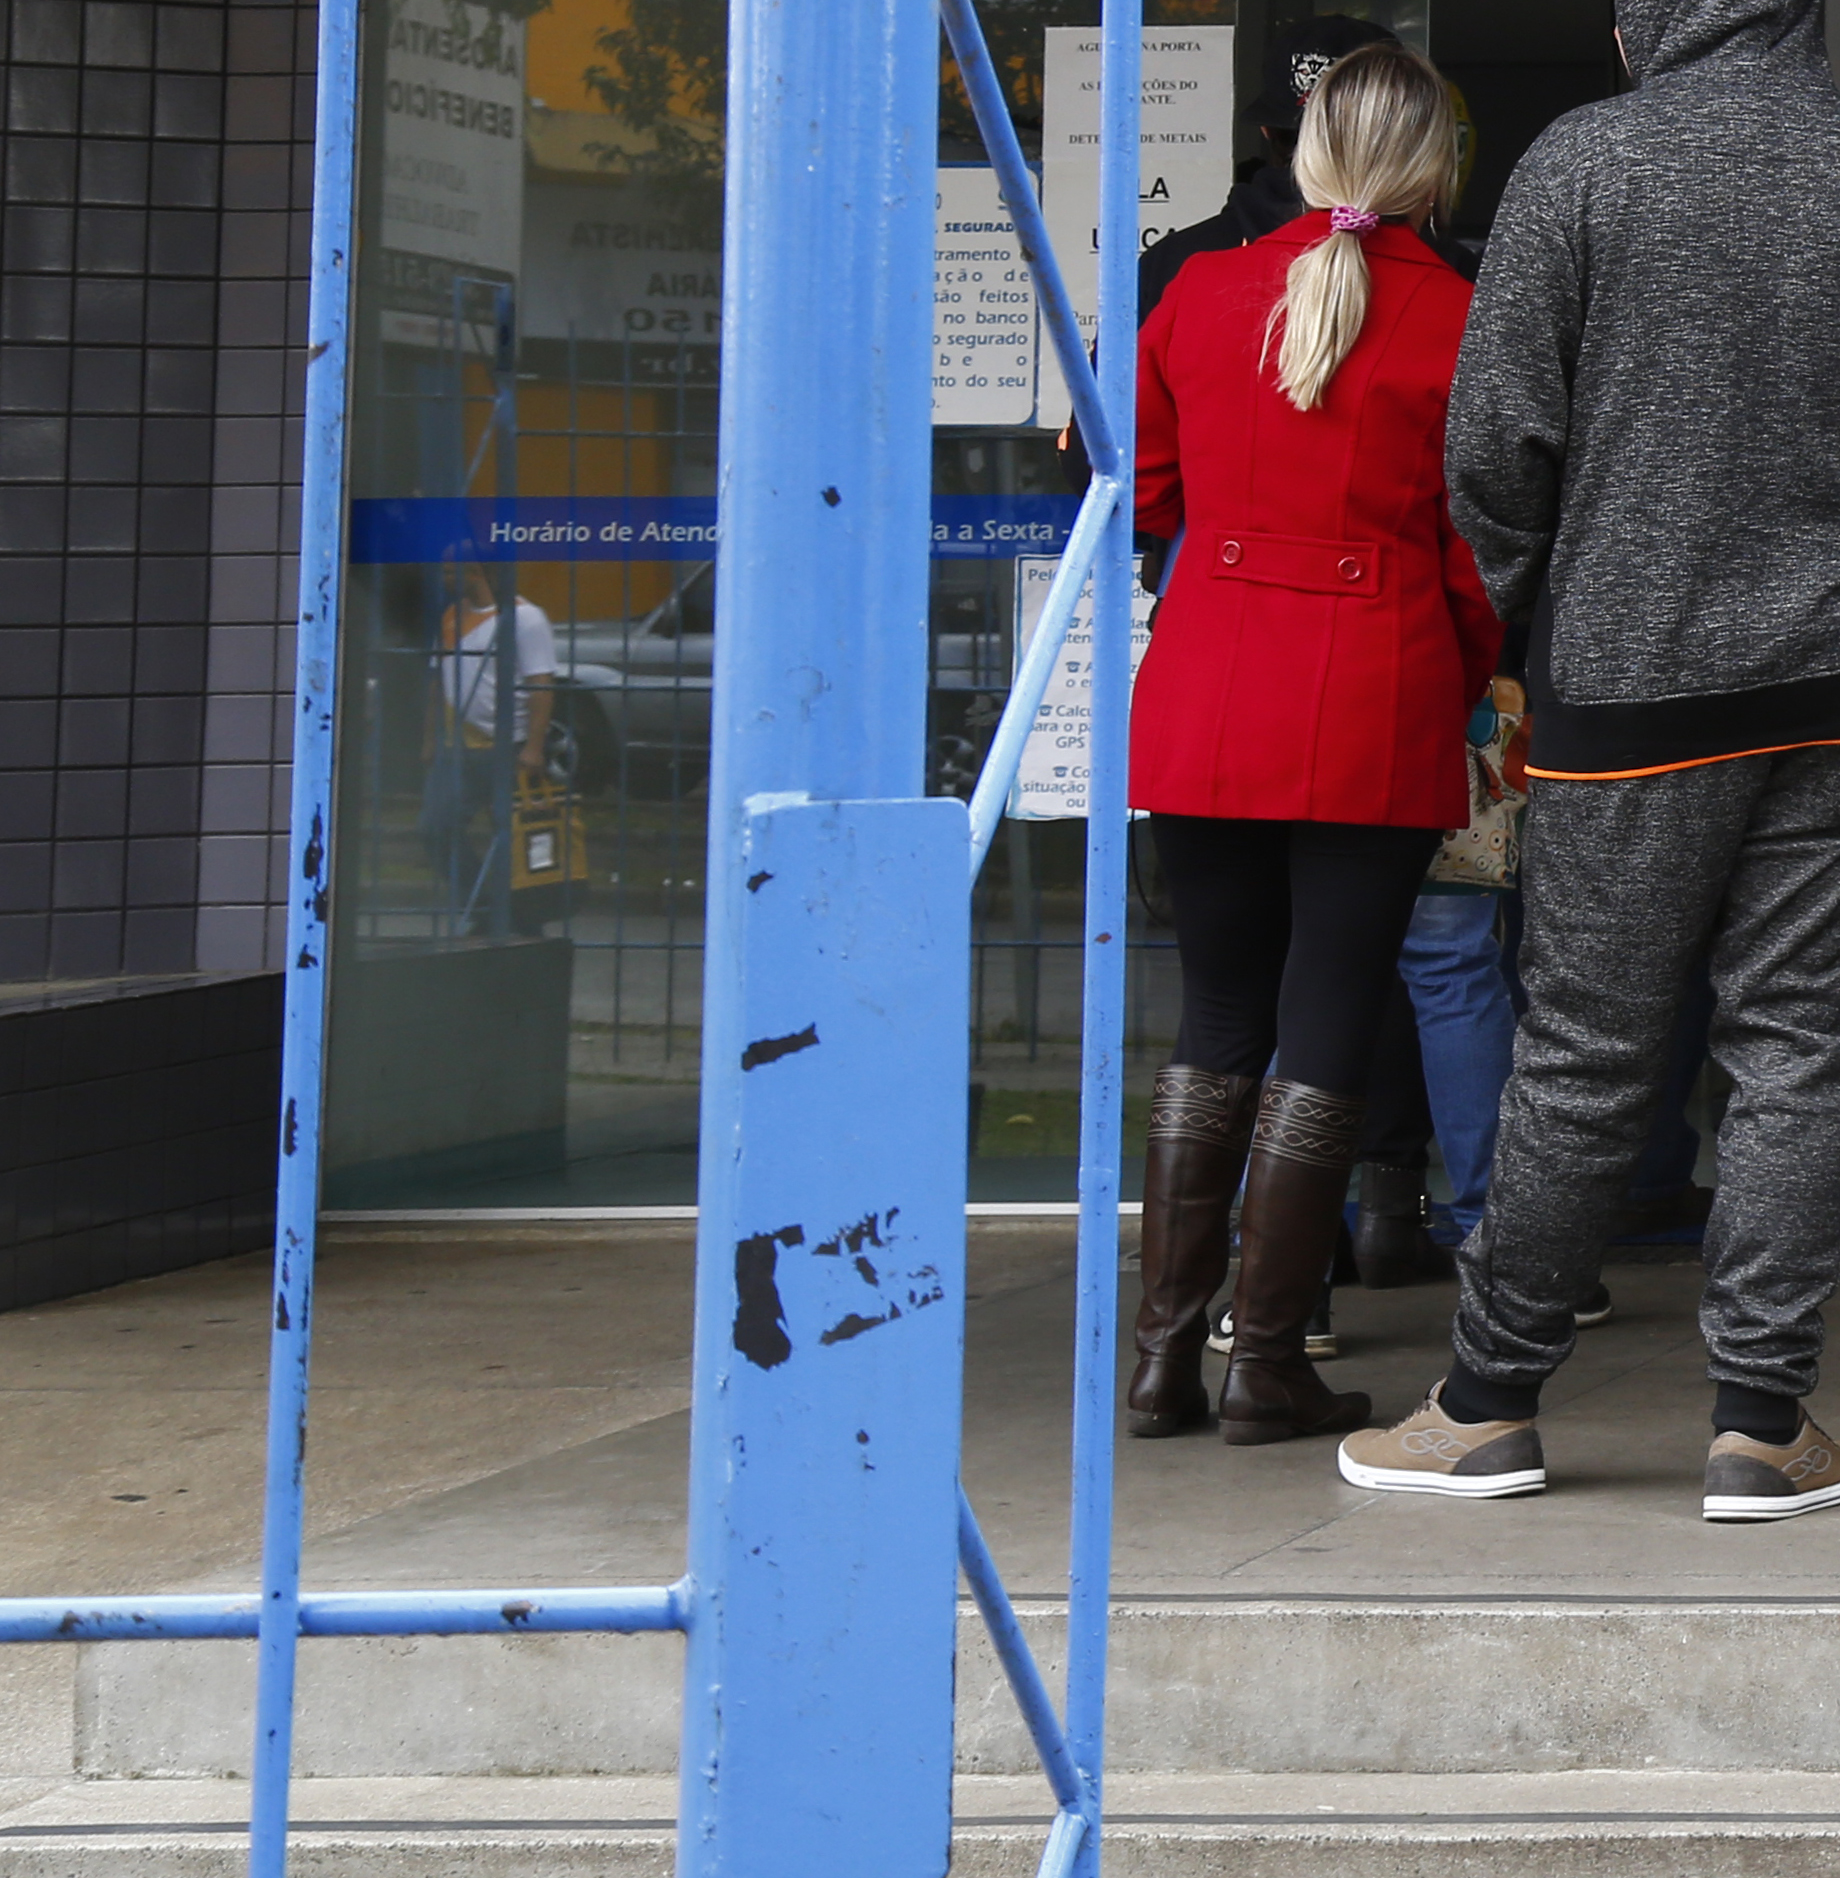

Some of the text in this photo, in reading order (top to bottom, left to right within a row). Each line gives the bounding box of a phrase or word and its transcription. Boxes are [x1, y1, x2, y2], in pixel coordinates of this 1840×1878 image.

[1160, 41, 1202, 52] PORTA
[1179, 80, 1198, 91] DO
[1159, 133, 1208, 144] METAIS
[978, 289, 1029, 304] feitos
[975, 311, 1028, 325] banco
[947, 332, 1028, 349] segurado
[965, 373, 988, 388] do
[996, 375, 1027, 388] seu
[489, 520, 591, 543] Horário
[599, 521, 633, 543] de
[982, 519, 1054, 541] Sexta
[1055, 736, 1086, 749] GPS
[1022, 780, 1086, 796] situação
